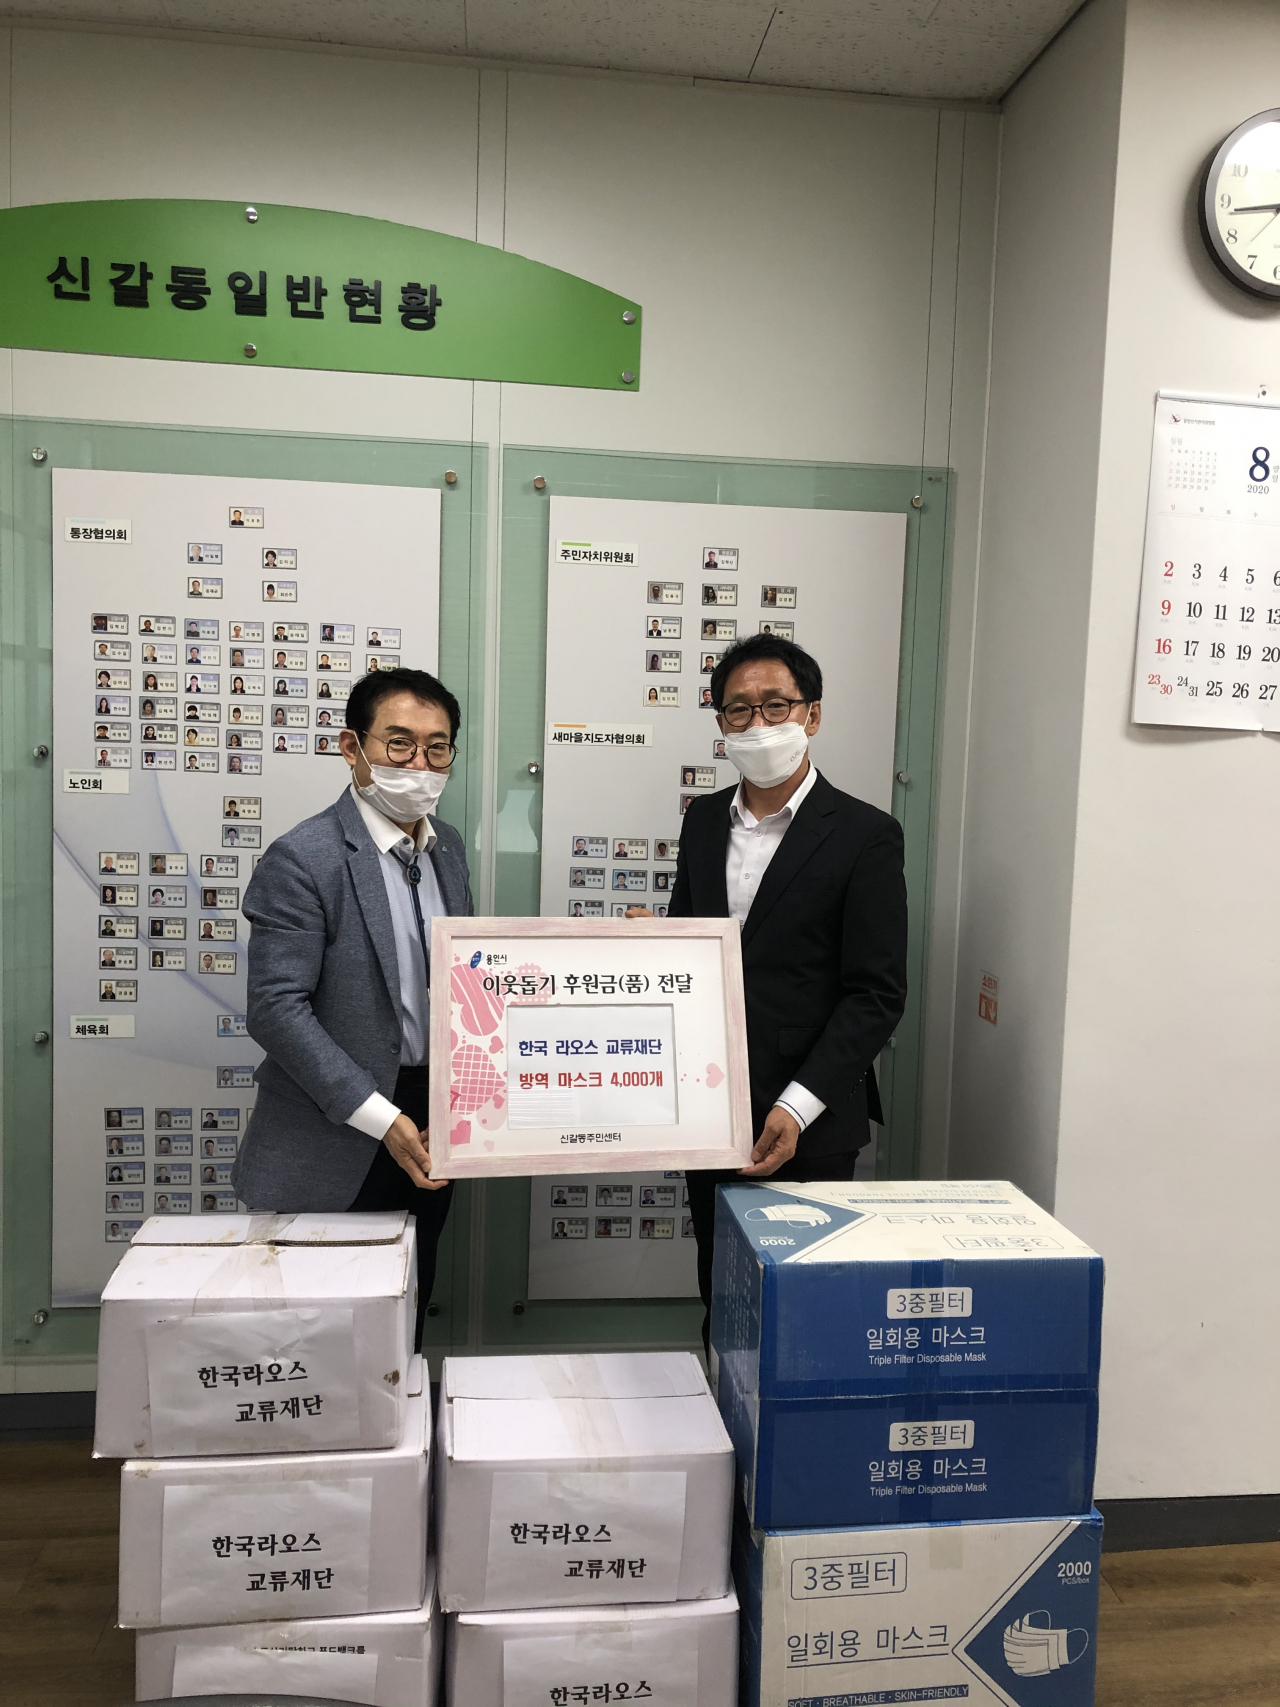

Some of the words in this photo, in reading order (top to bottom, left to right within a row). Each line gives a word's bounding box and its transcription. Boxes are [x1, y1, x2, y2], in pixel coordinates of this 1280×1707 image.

[1220, 193, 1232, 209] 9
[1226, 228, 1238, 245] 8
[1247, 254, 1258, 270] 7
[46, 256, 443, 331] 신갈동일반현황
[1248, 446, 1270, 483] 8
[1247, 484, 1270, 495] 2020
[69, 526, 127, 541] 통장협의회
[560, 549, 634, 564] 주민자치위원회
[1163, 560, 1174, 577] 2
[1192, 563, 1202, 579] 3
[1219, 566, 1228, 582] 4
[1245, 568, 1255, 585] 5
[1161, 599, 1172, 616] 9
[1186, 601, 1203, 618] 10
[1213, 604, 1228, 621] 11
[1239, 606, 1255, 623] 12
[1266, 608, 1280, 625] 13
[1155, 638, 1172, 655] 16
[1183, 640, 1199, 657] 17
[1209, 642, 1226, 659] 18
[1235, 644, 1251, 661] 19
[1261, 646, 1280, 663] 20
[1148, 674, 1161, 685] 23
[1177, 676, 1189, 687] 24
[1206, 680, 1223, 697] 25
[1232, 682, 1249, 699] 26
[1258, 684, 1278, 701] 27
[1160, 684, 1173, 695] 30
[1188, 686, 1198, 697] 31
[552, 731, 646, 745] 새마을지도자협의회
[68, 778, 103, 790] 노인회
[486, 954, 508, 966] 용인시
[483, 974, 556, 997] 이웃돕기
[562, 973, 651, 996] 후원금(품)
[657, 972, 693, 995] 전달
[75, 1024, 109, 1036] 체육회
[518, 1040, 548, 1057] 한국
[555, 1039, 598, 1056] 라오스
[605, 1038, 662, 1056] 교류재단
[519, 1073, 549, 1090] 방역
[558, 1072, 603, 1089] 마스크
[610, 1070, 664, 1088] 4,000개
[560, 1132, 622, 1144] 신갈동주민센터
[759, 1238, 797, 1246] 2000
[896, 1291, 965, 1314] 3중필터
[866, 1326, 921, 1350] 일회용
[931, 1325, 987, 1348] 마스크
[869, 1355, 892, 1366] Triple
[894, 1354, 915, 1365] Filter
[917, 1353, 963, 1364] Disposable
[964, 1352, 987, 1362] Mask
[197, 1361, 308, 1388] 한국라오스
[235, 1394, 323, 1422] 교류재단
[898, 1424, 967, 1446] 3중필터
[868, 1459, 923, 1482] 일회용
[933, 1457, 988, 1479] 마스크
[870, 1486, 893, 1497] Triple
[895, 1485, 915, 1495] Filter
[917, 1484, 963, 1495] Disposable
[965, 1483, 987, 1493] Mask
[510, 1522, 612, 1545] 한국라오스
[211, 1532, 322, 1558] 한국라오스
[245, 1567, 335, 1592] 교류재단
[564, 1558, 647, 1579] 교류재단
[803, 1558, 897, 1591] 3중필터
[1057, 1561, 1092, 1577] 2000
[786, 1629, 861, 1663] 일회용
[876, 1624, 949, 1654] 마스크
[549, 1681, 653, 1707] 한국라오스
[822, 1692, 885, 1707] BREATHABLE
[894, 1685, 969, 1701] SKIN-FRIENDLY
